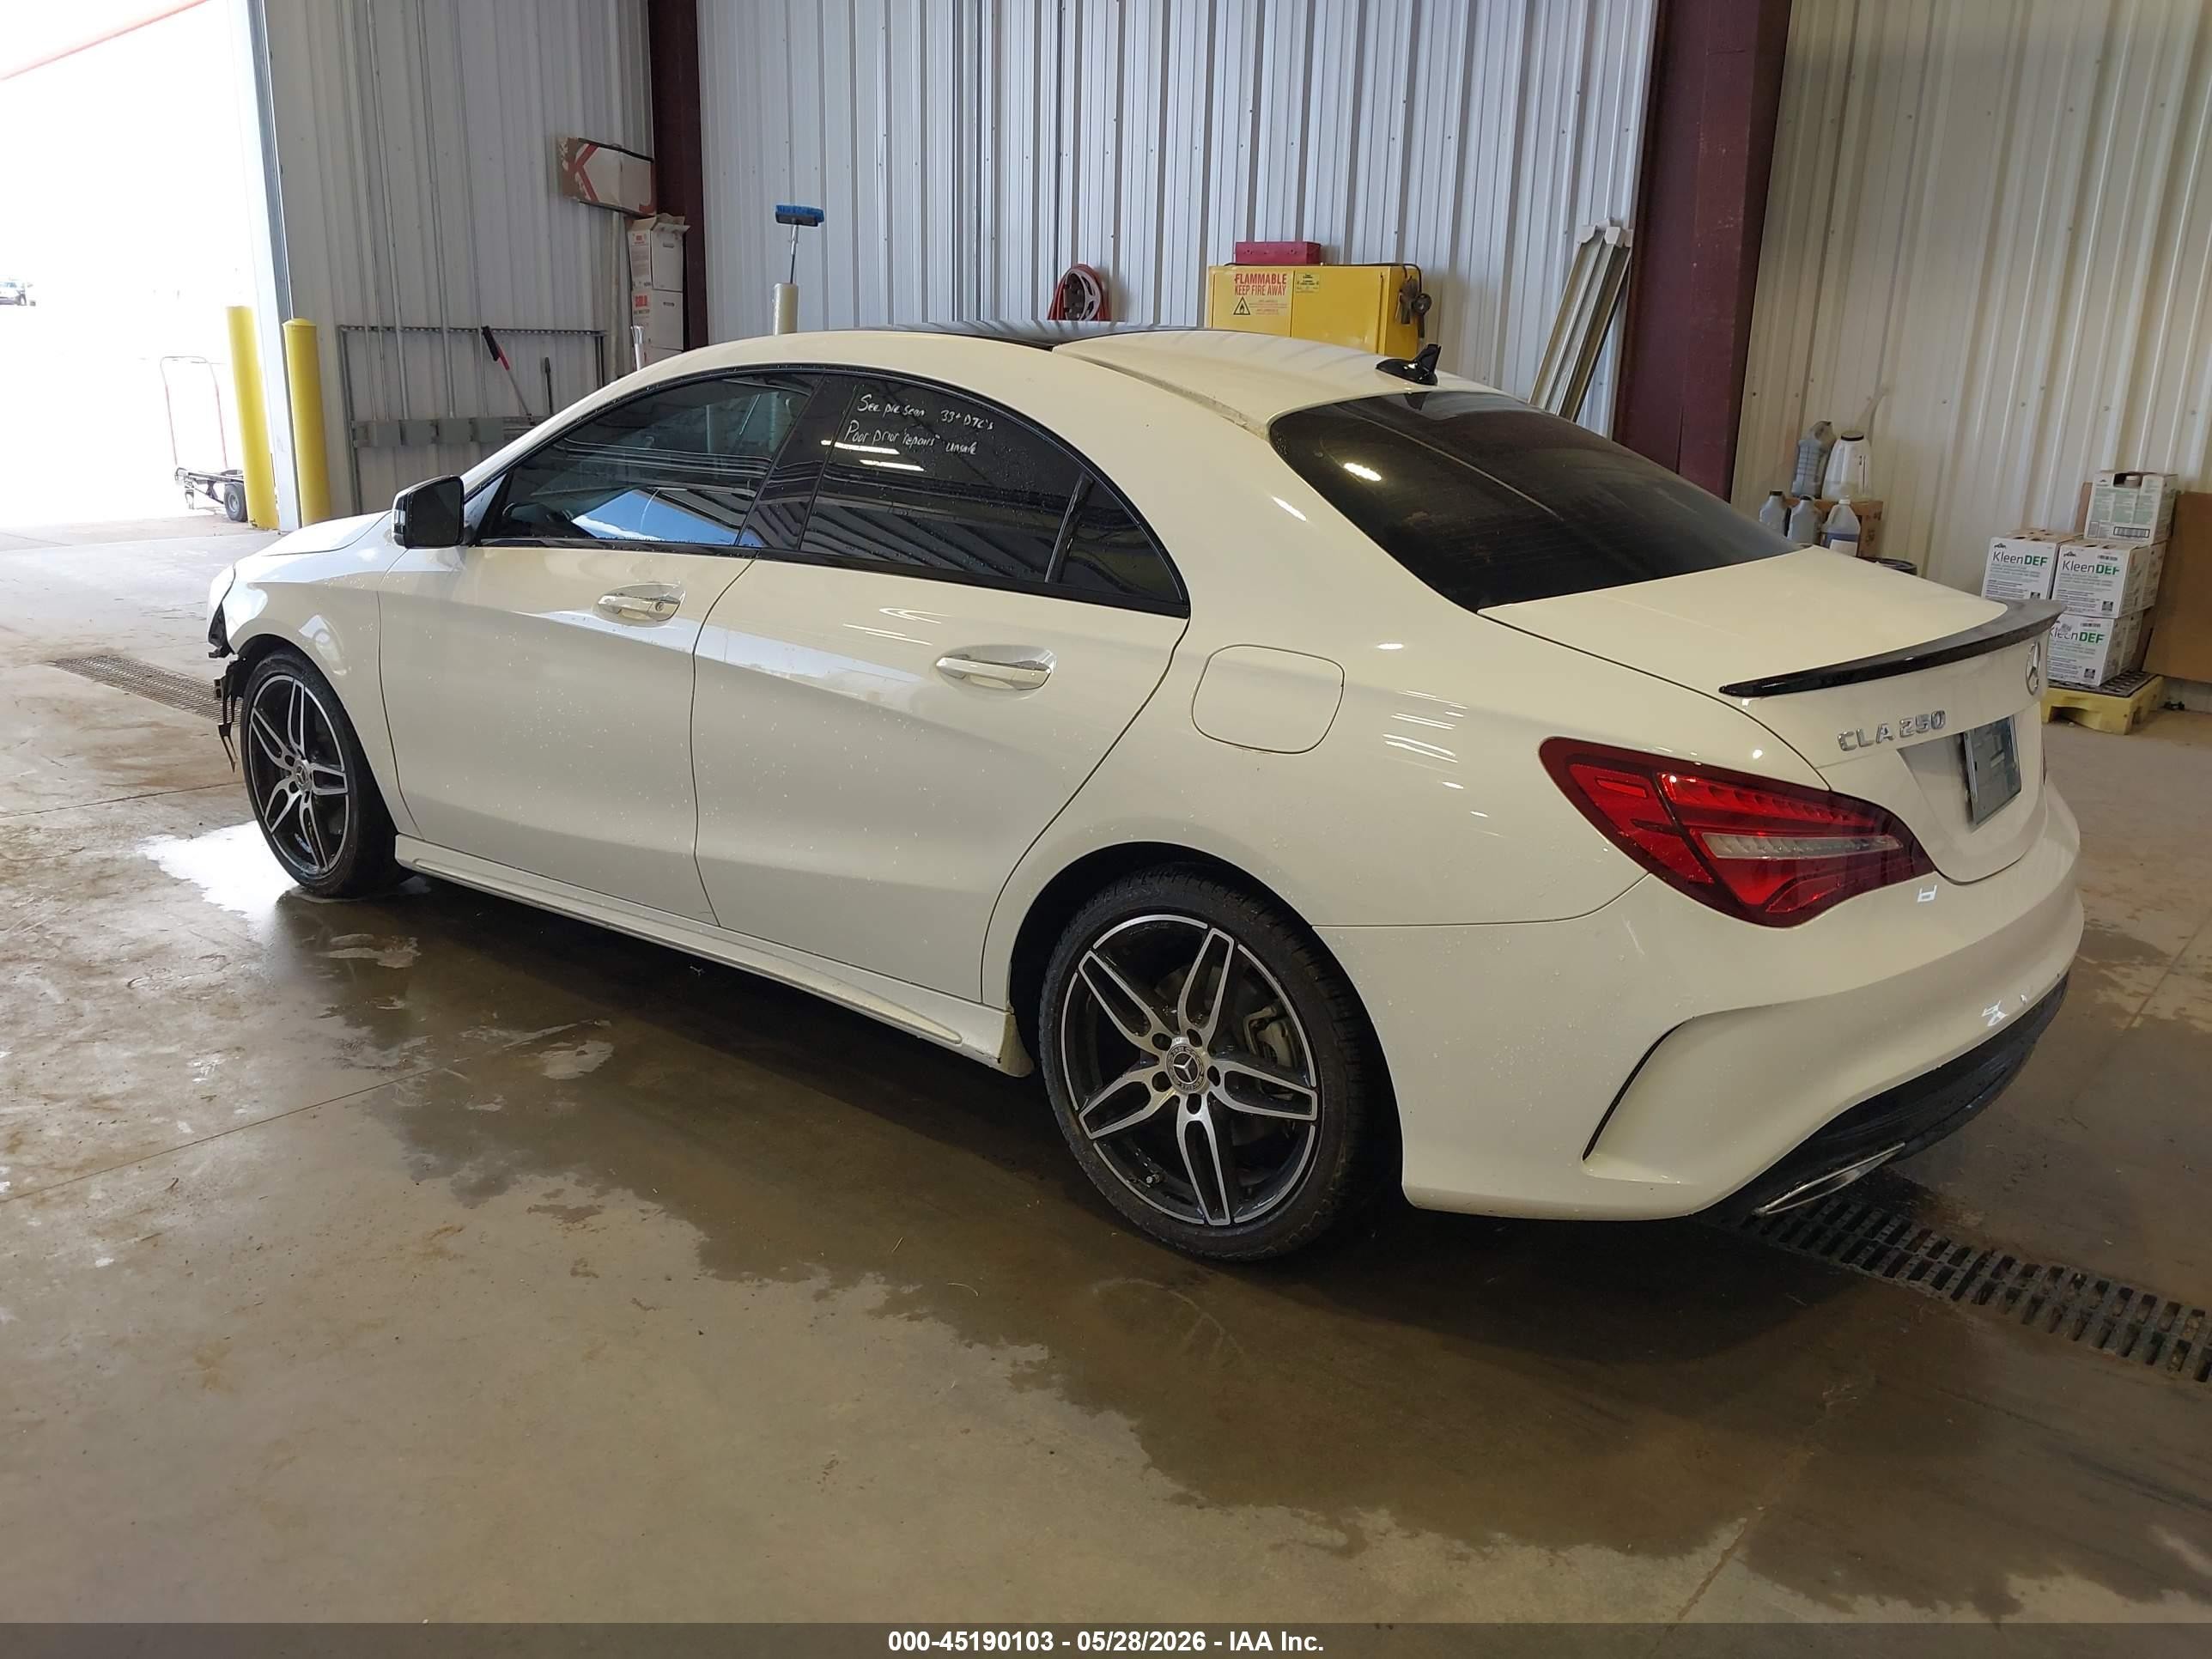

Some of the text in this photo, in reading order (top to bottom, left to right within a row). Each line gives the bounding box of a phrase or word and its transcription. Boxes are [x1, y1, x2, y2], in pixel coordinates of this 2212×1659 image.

[1235, 273, 1287, 284] FLAMMABLE
[1235, 284, 1286, 296] KEEP FIRE AWAY
[857, 394, 881, 412] See
[844, 419, 870, 443] Poor
[872, 429, 900, 446] prior
[1992, 551, 2048, 568] KleenDEF
[1838, 710, 1946, 751] CLA 250
